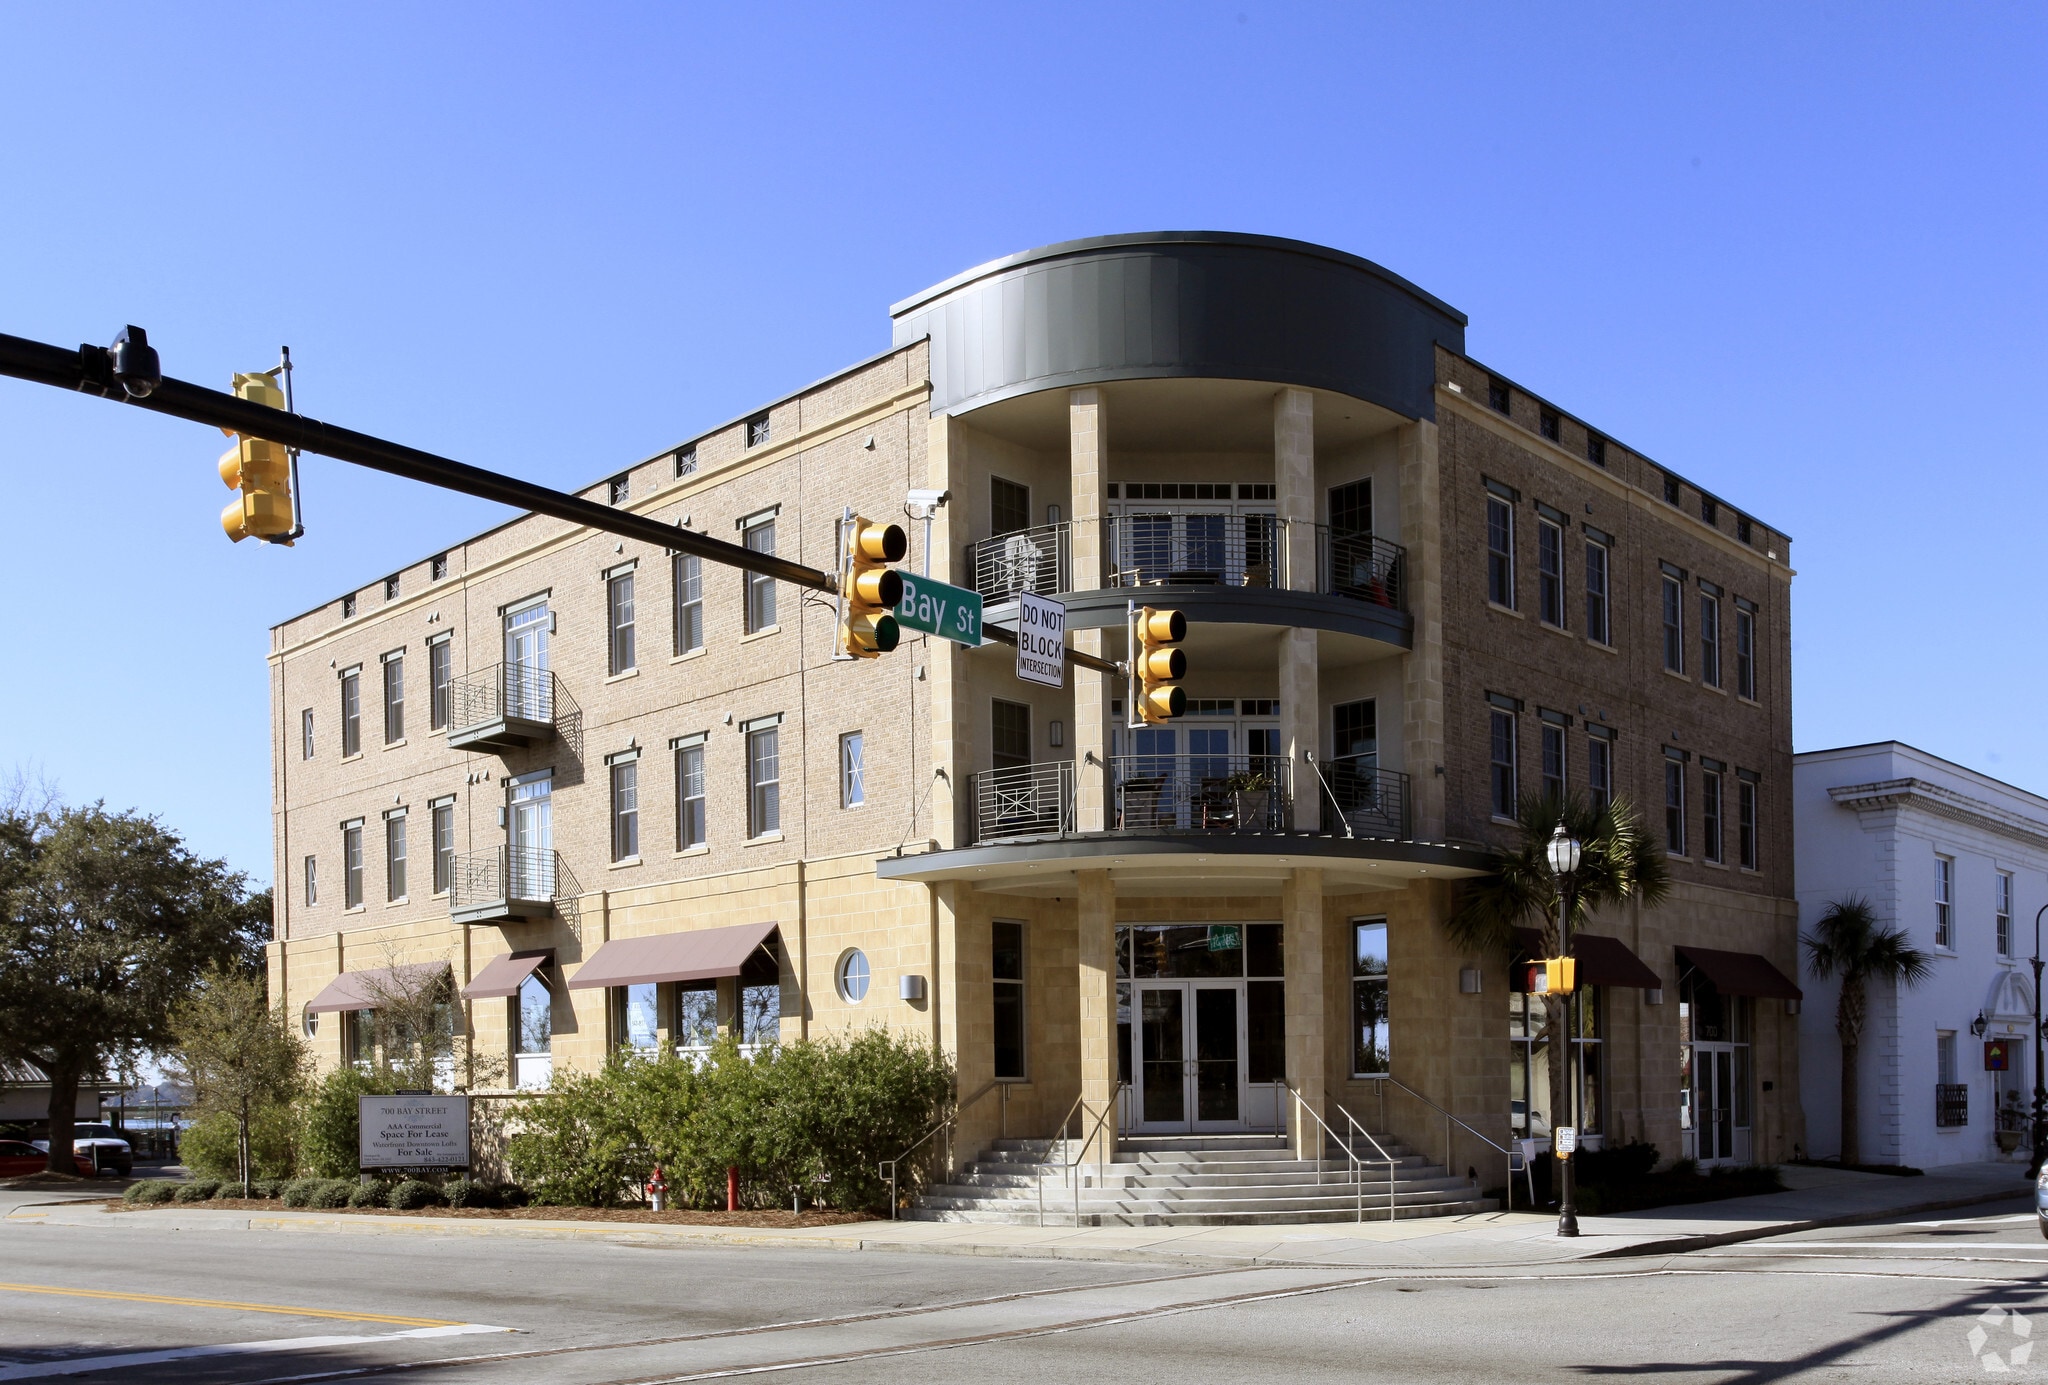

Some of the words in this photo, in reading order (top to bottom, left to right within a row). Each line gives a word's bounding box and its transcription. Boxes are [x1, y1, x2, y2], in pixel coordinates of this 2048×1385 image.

[901, 581, 946, 634] Bay
[956, 605, 974, 635] St
[1022, 603, 1038, 625] DO
[1041, 609, 1063, 632] NOT
[1021, 632, 1062, 660] BLOCK
[1020, 657, 1062, 679] INTERSECTION
[380, 1107, 395, 1115] 700
[397, 1107, 414, 1115] BAY
[380, 1130, 405, 1140] Space
[407, 1130, 423, 1138] For
[425, 1130, 449, 1138] Lease
[397, 1148, 413, 1156] For
[415, 1148, 433, 1156] Sale
